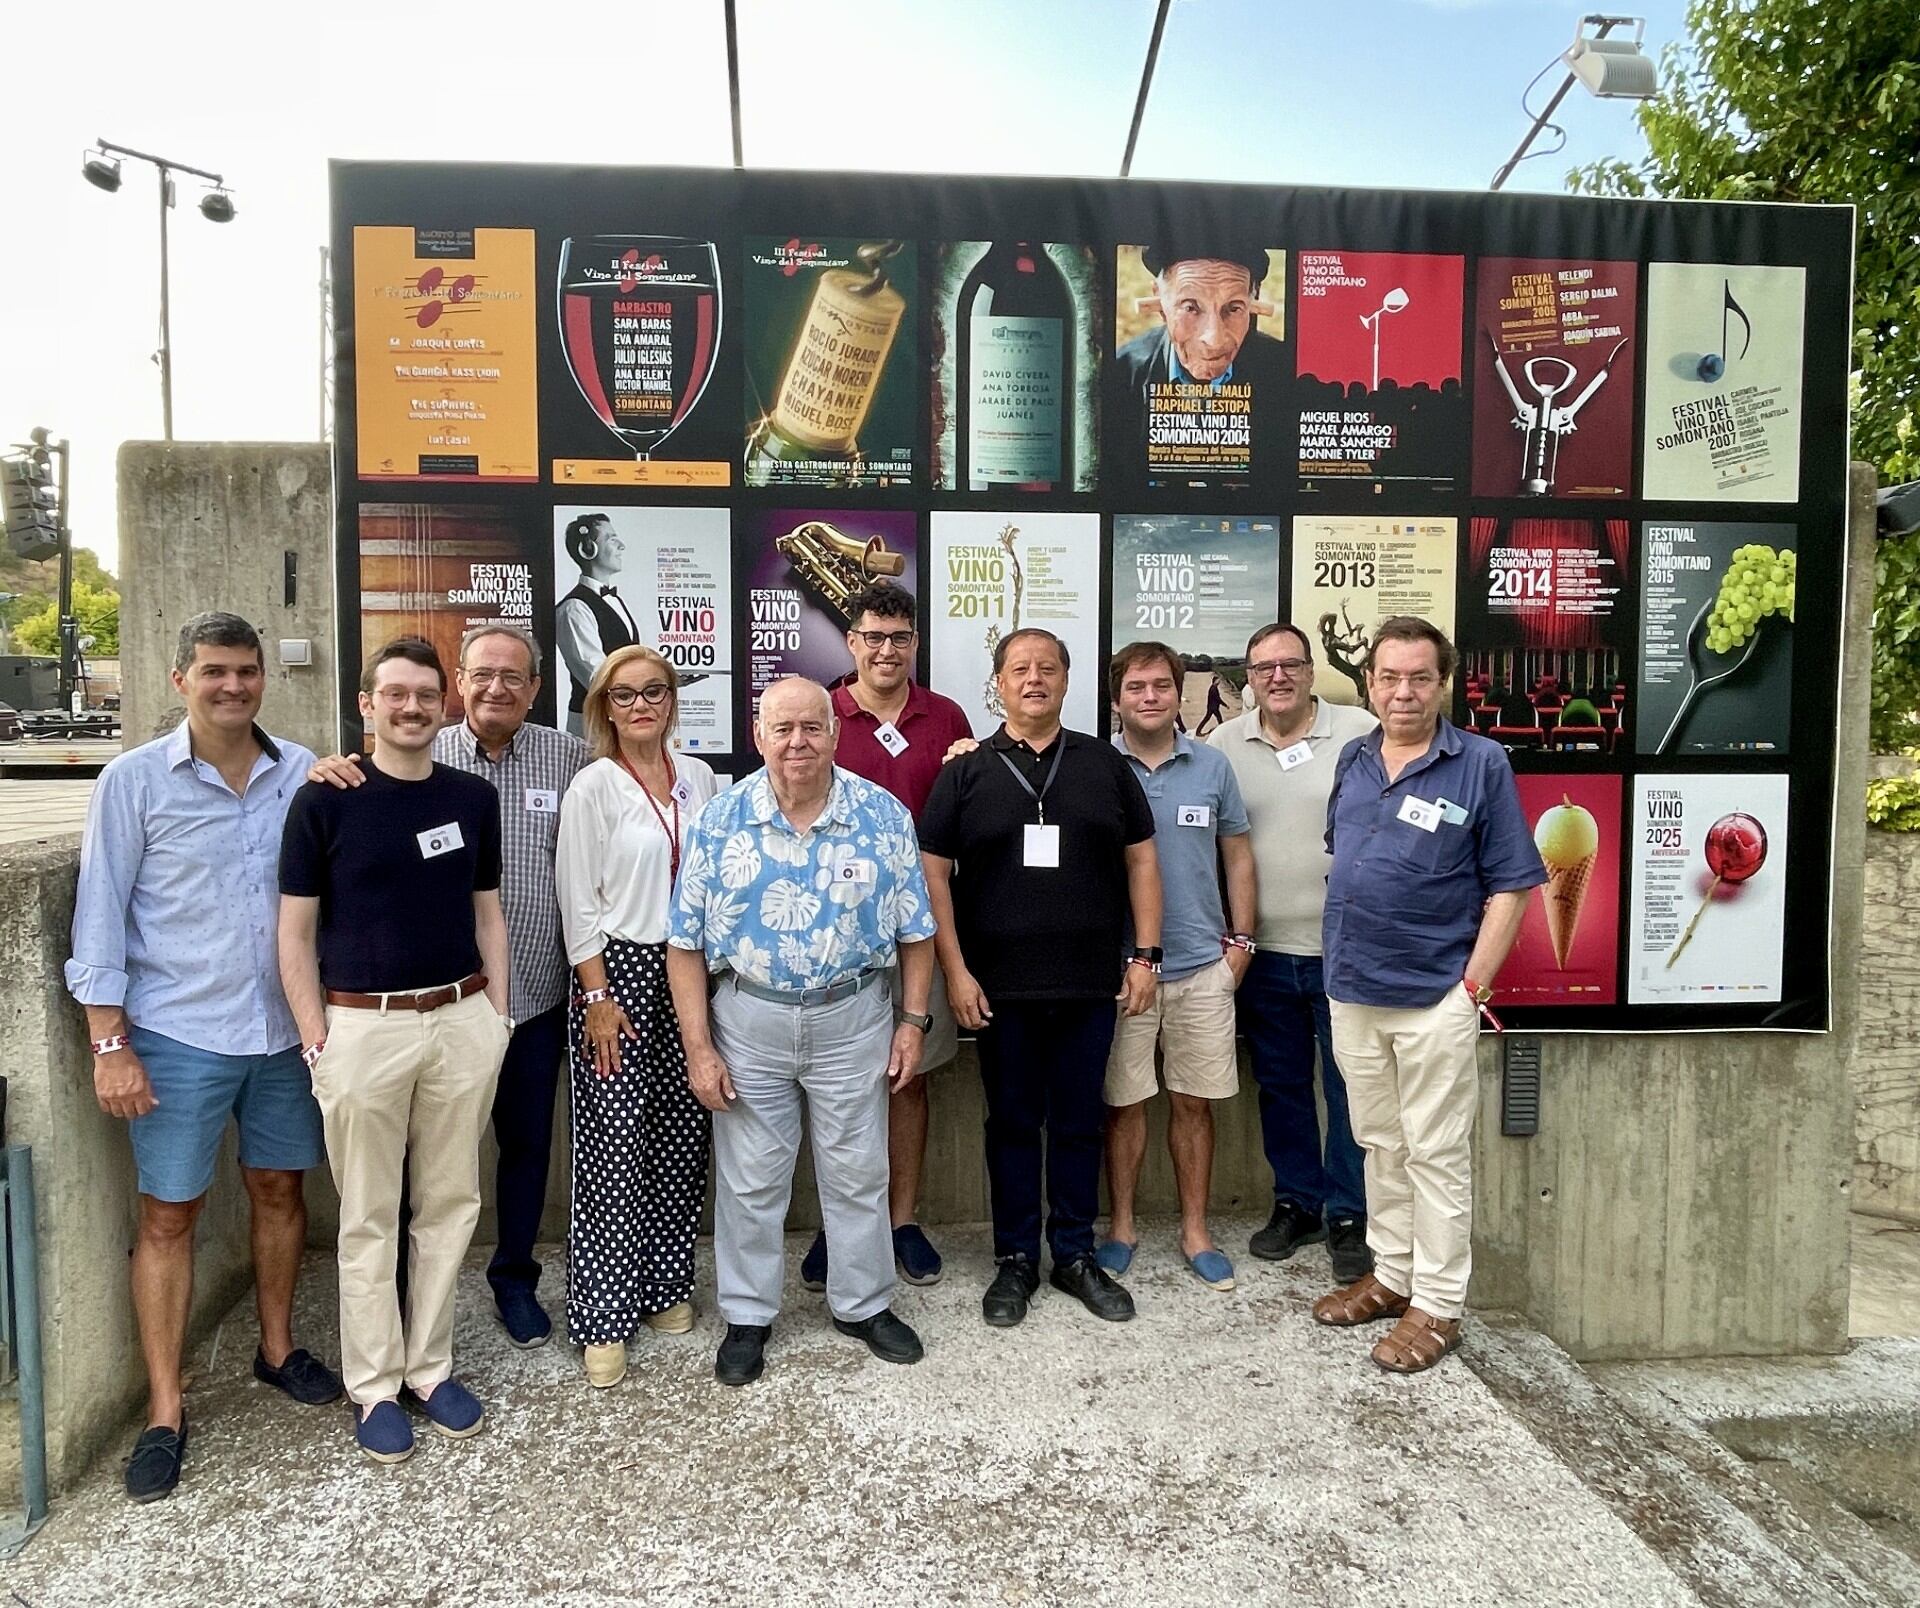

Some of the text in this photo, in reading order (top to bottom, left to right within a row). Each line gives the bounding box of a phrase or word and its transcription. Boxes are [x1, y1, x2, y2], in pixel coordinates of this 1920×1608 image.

[788, 247, 827, 258] Festival
[622, 259, 668, 271] Festival
[752, 255, 776, 265] Vino
[778, 256, 794, 266] del
[1302, 255, 1342, 265] FESTIVAL
[584, 268, 697, 282] Vino del Somontano
[1302, 266, 1345, 276] VINO DEL
[1302, 276, 1367, 287] SOMONTANO
[1511, 273, 1554, 287] FESTIVAL
[1302, 286, 1326, 296] 2005
[1512, 284, 1555, 298] VINO DEL
[1559, 288, 1618, 302] SERGIO DALMA
[613, 301, 672, 314] BARBASTRO
[1500, 295, 1555, 310] SOMONTANO
[614, 318, 671, 330] SARA BARAS
[614, 333, 672, 346] EVA AMARAL
[614, 350, 672, 365] JULIO IGLESIAS
[839, 342, 881, 364] JURADO
[614, 368, 672, 380] ANA BELEN Y
[983, 370, 1050, 380] DAVID CIVERA
[614, 380, 672, 391] VICTOR MANUEL
[792, 369, 864, 411] CHAYANNE
[982, 384, 1050, 393] ANA TORROJA
[1222, 382, 1251, 398] MALÚ
[615, 399, 673, 410] SOMONTANO
[784, 390, 822, 425] MIGUEL
[977, 397, 1011, 406] JARABE
[1015, 398, 1027, 406] DE
[1156, 398, 1250, 413] RAPHAEL ESTOPA
[1672, 394, 1730, 419] FESTIVAL
[997, 411, 1035, 419] JUANES
[1149, 414, 1251, 429] FESTIVAL VINO DEL
[1300, 411, 1370, 423] MIGUEL RIOS
[1675, 408, 1733, 431] VINO DEL
[1149, 428, 1250, 445] SOMONTANO 2004
[1300, 424, 1393, 437] RAFAEL AMARGO
[1656, 420, 1735, 450] SOMONTANO
[1299, 436, 1391, 448] MARTA SANCHEZ
[1708, 432, 1737, 450] 2007
[1299, 449, 1376, 460] BONNIE TYLER
[794, 459, 850, 470] GASTRONÓMICA
[853, 462, 866, 471] DEL
[869, 462, 912, 471] SOMONTANO
[1648, 527, 1696, 542] FESTIVAL
[947, 546, 1005, 559] FESTIVAL
[1315, 541, 1354, 551] FESTIVAL
[1356, 542, 1376, 551] VINO
[1490, 547, 1553, 558] FESTIVAL VINO
[1648, 542, 1673, 556] VINO
[1136, 554, 1195, 567] FESTIVAL
[1315, 551, 1376, 562] SOMONTANO
[1489, 557, 1553, 569] SOMONTANO
[1647, 556, 1712, 571] SOMONTANO
[470, 564, 532, 578] FESTIVAL
[948, 560, 1004, 582] VINO
[1314, 562, 1375, 588] 2013
[1647, 570, 1674, 584] 2015
[471, 577, 532, 591] VINO DEL
[1137, 568, 1194, 592] VINO
[1488, 569, 1552, 597] 2014
[947, 583, 1005, 593] SOMONTANO
[447, 590, 533, 604] SOMONTANO
[750, 590, 800, 601] FESTIVAL
[1136, 592, 1195, 603] SOMONTANO
[658, 596, 714, 609] FESTIVAL
[948, 595, 1004, 618] 2011
[500, 603, 533, 617] 2008
[751, 601, 801, 621] VINO
[466, 618, 487, 626] DAVID
[658, 610, 715, 632] VINO
[1136, 605, 1194, 629] 2012
[751, 621, 801, 630] SOMONTANO
[658, 633, 715, 643] SOMONTANO
[751, 631, 801, 651] 2010
[658, 644, 715, 666] 2009
[1647, 790, 1683, 800] FESTIVAL
[1647, 801, 1683, 819] VINO
